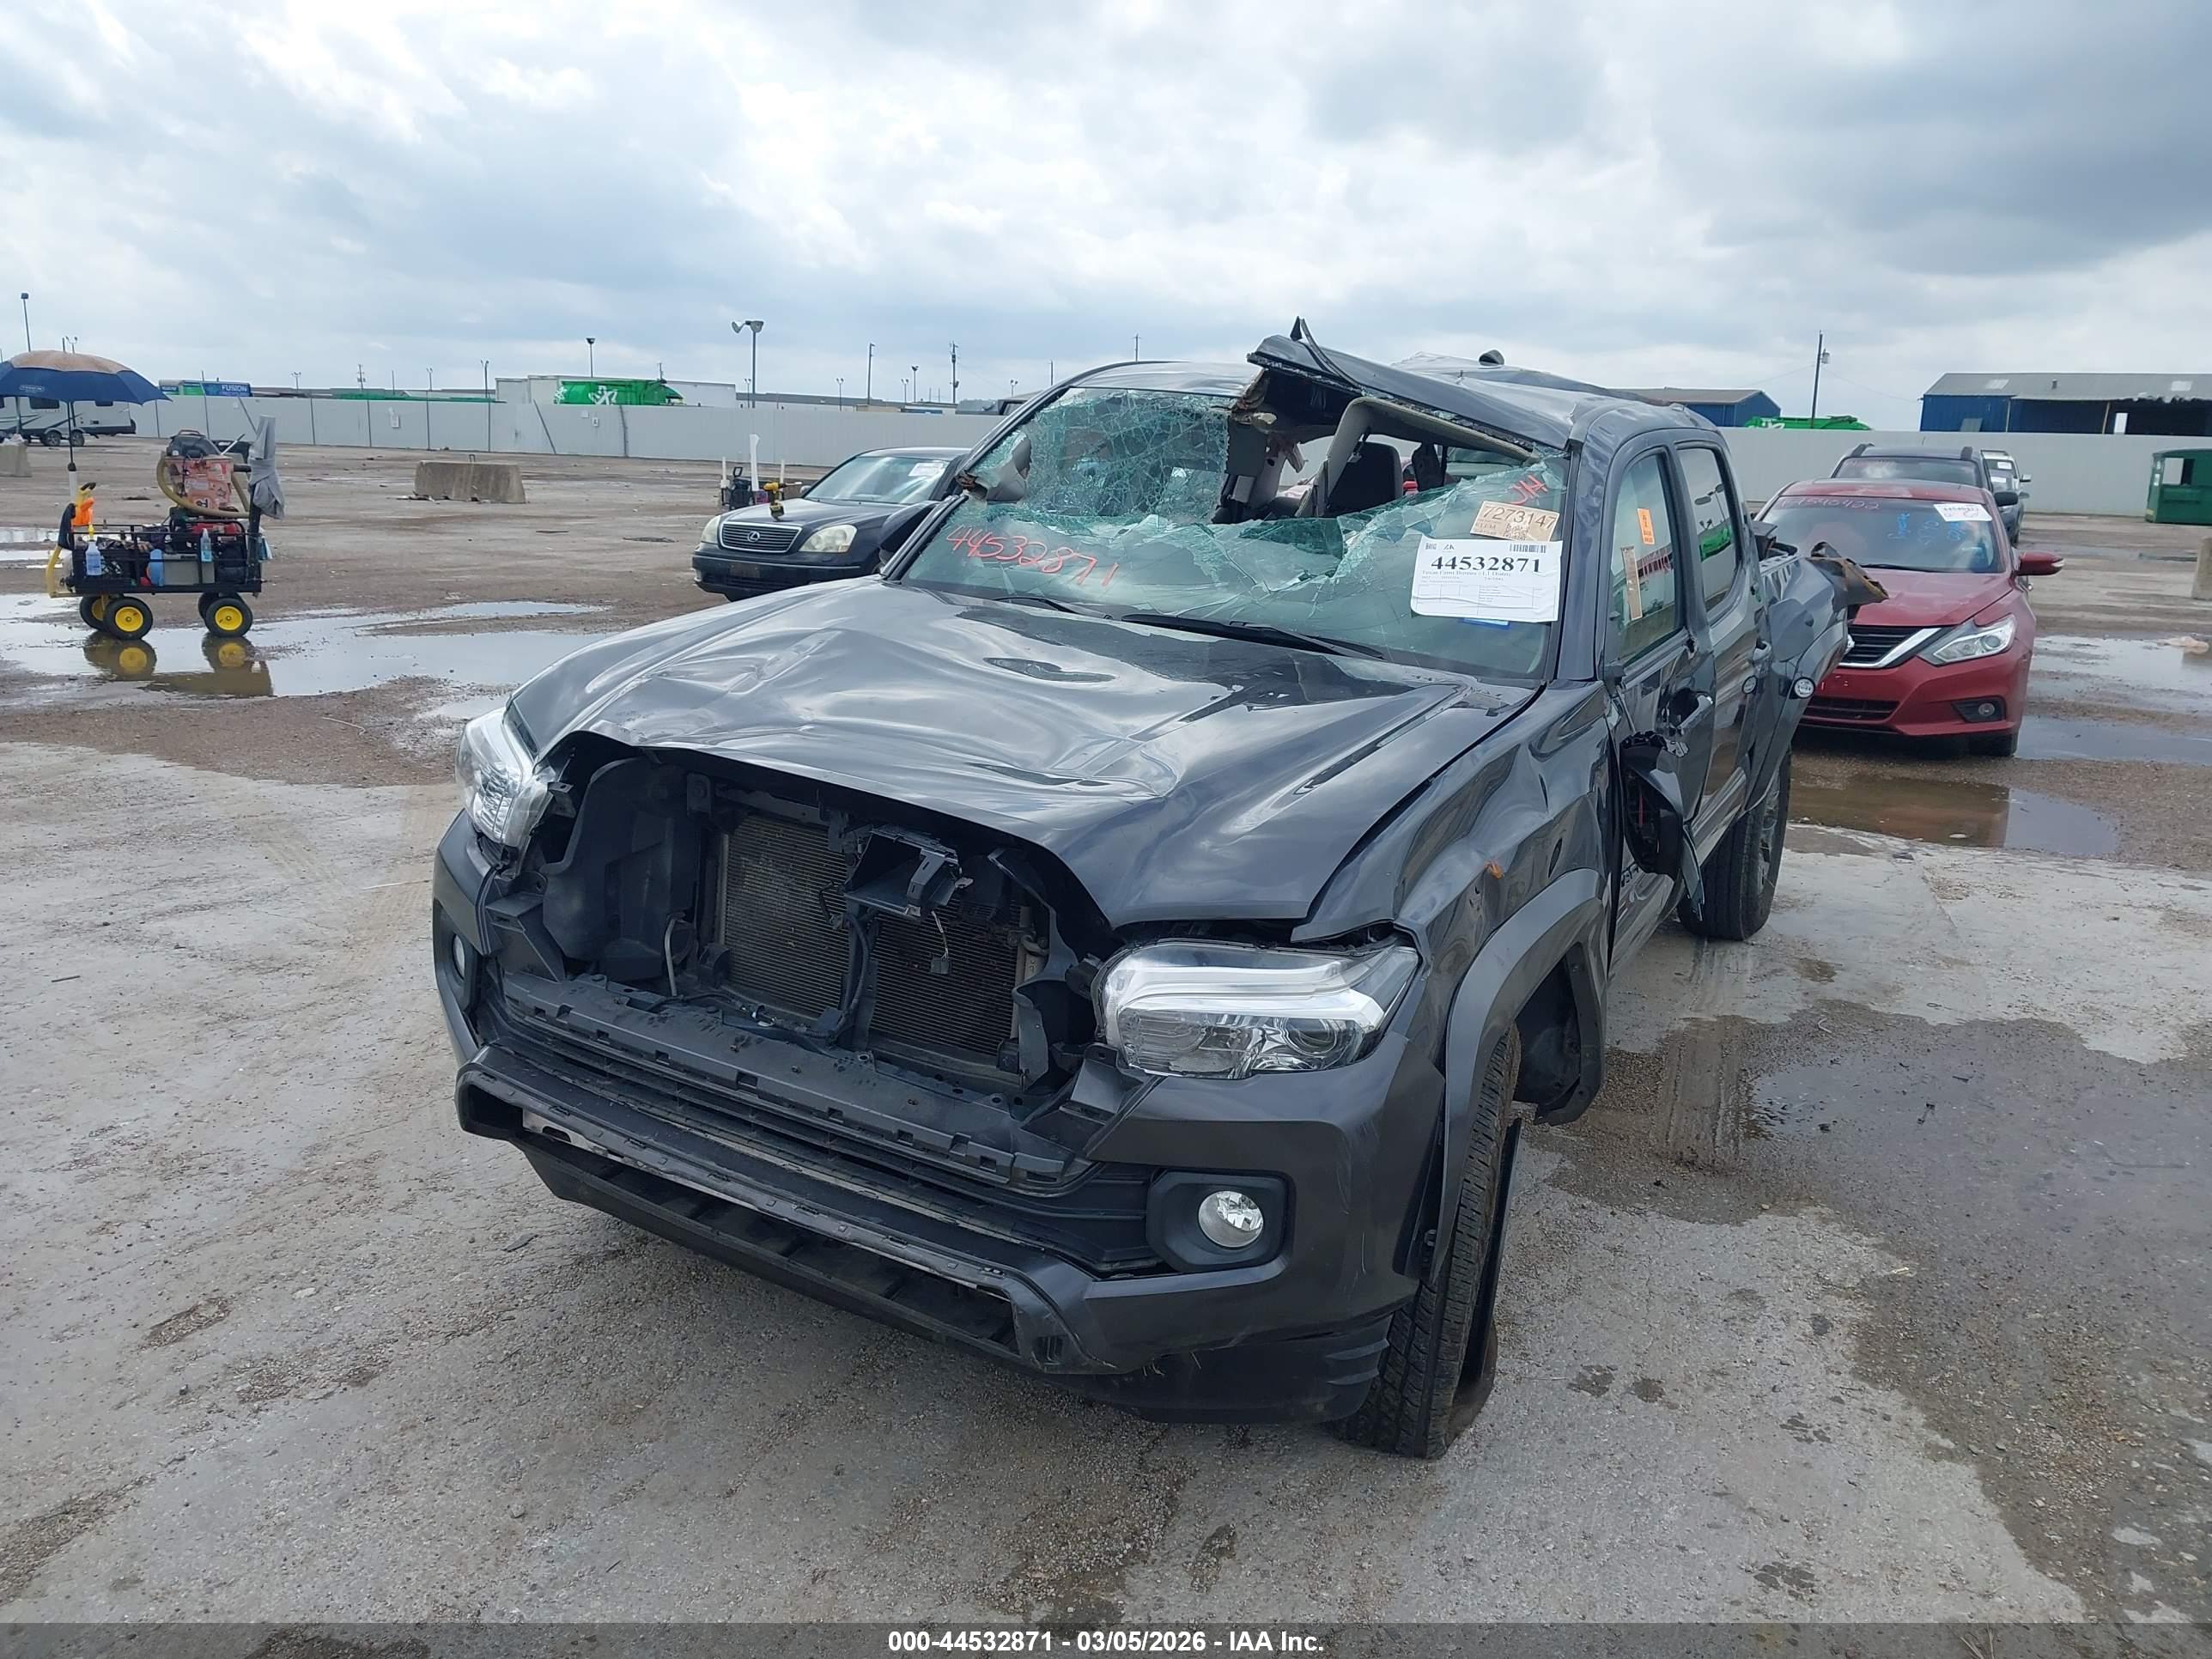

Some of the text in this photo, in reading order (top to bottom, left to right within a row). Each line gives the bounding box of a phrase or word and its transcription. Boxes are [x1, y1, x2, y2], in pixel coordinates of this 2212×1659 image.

[221, 385, 248, 393] FUSION
[1482, 505, 1557, 528] 7273147
[946, 526, 1119, 586] 44532871
[1431, 556, 1540, 573] 44532871
